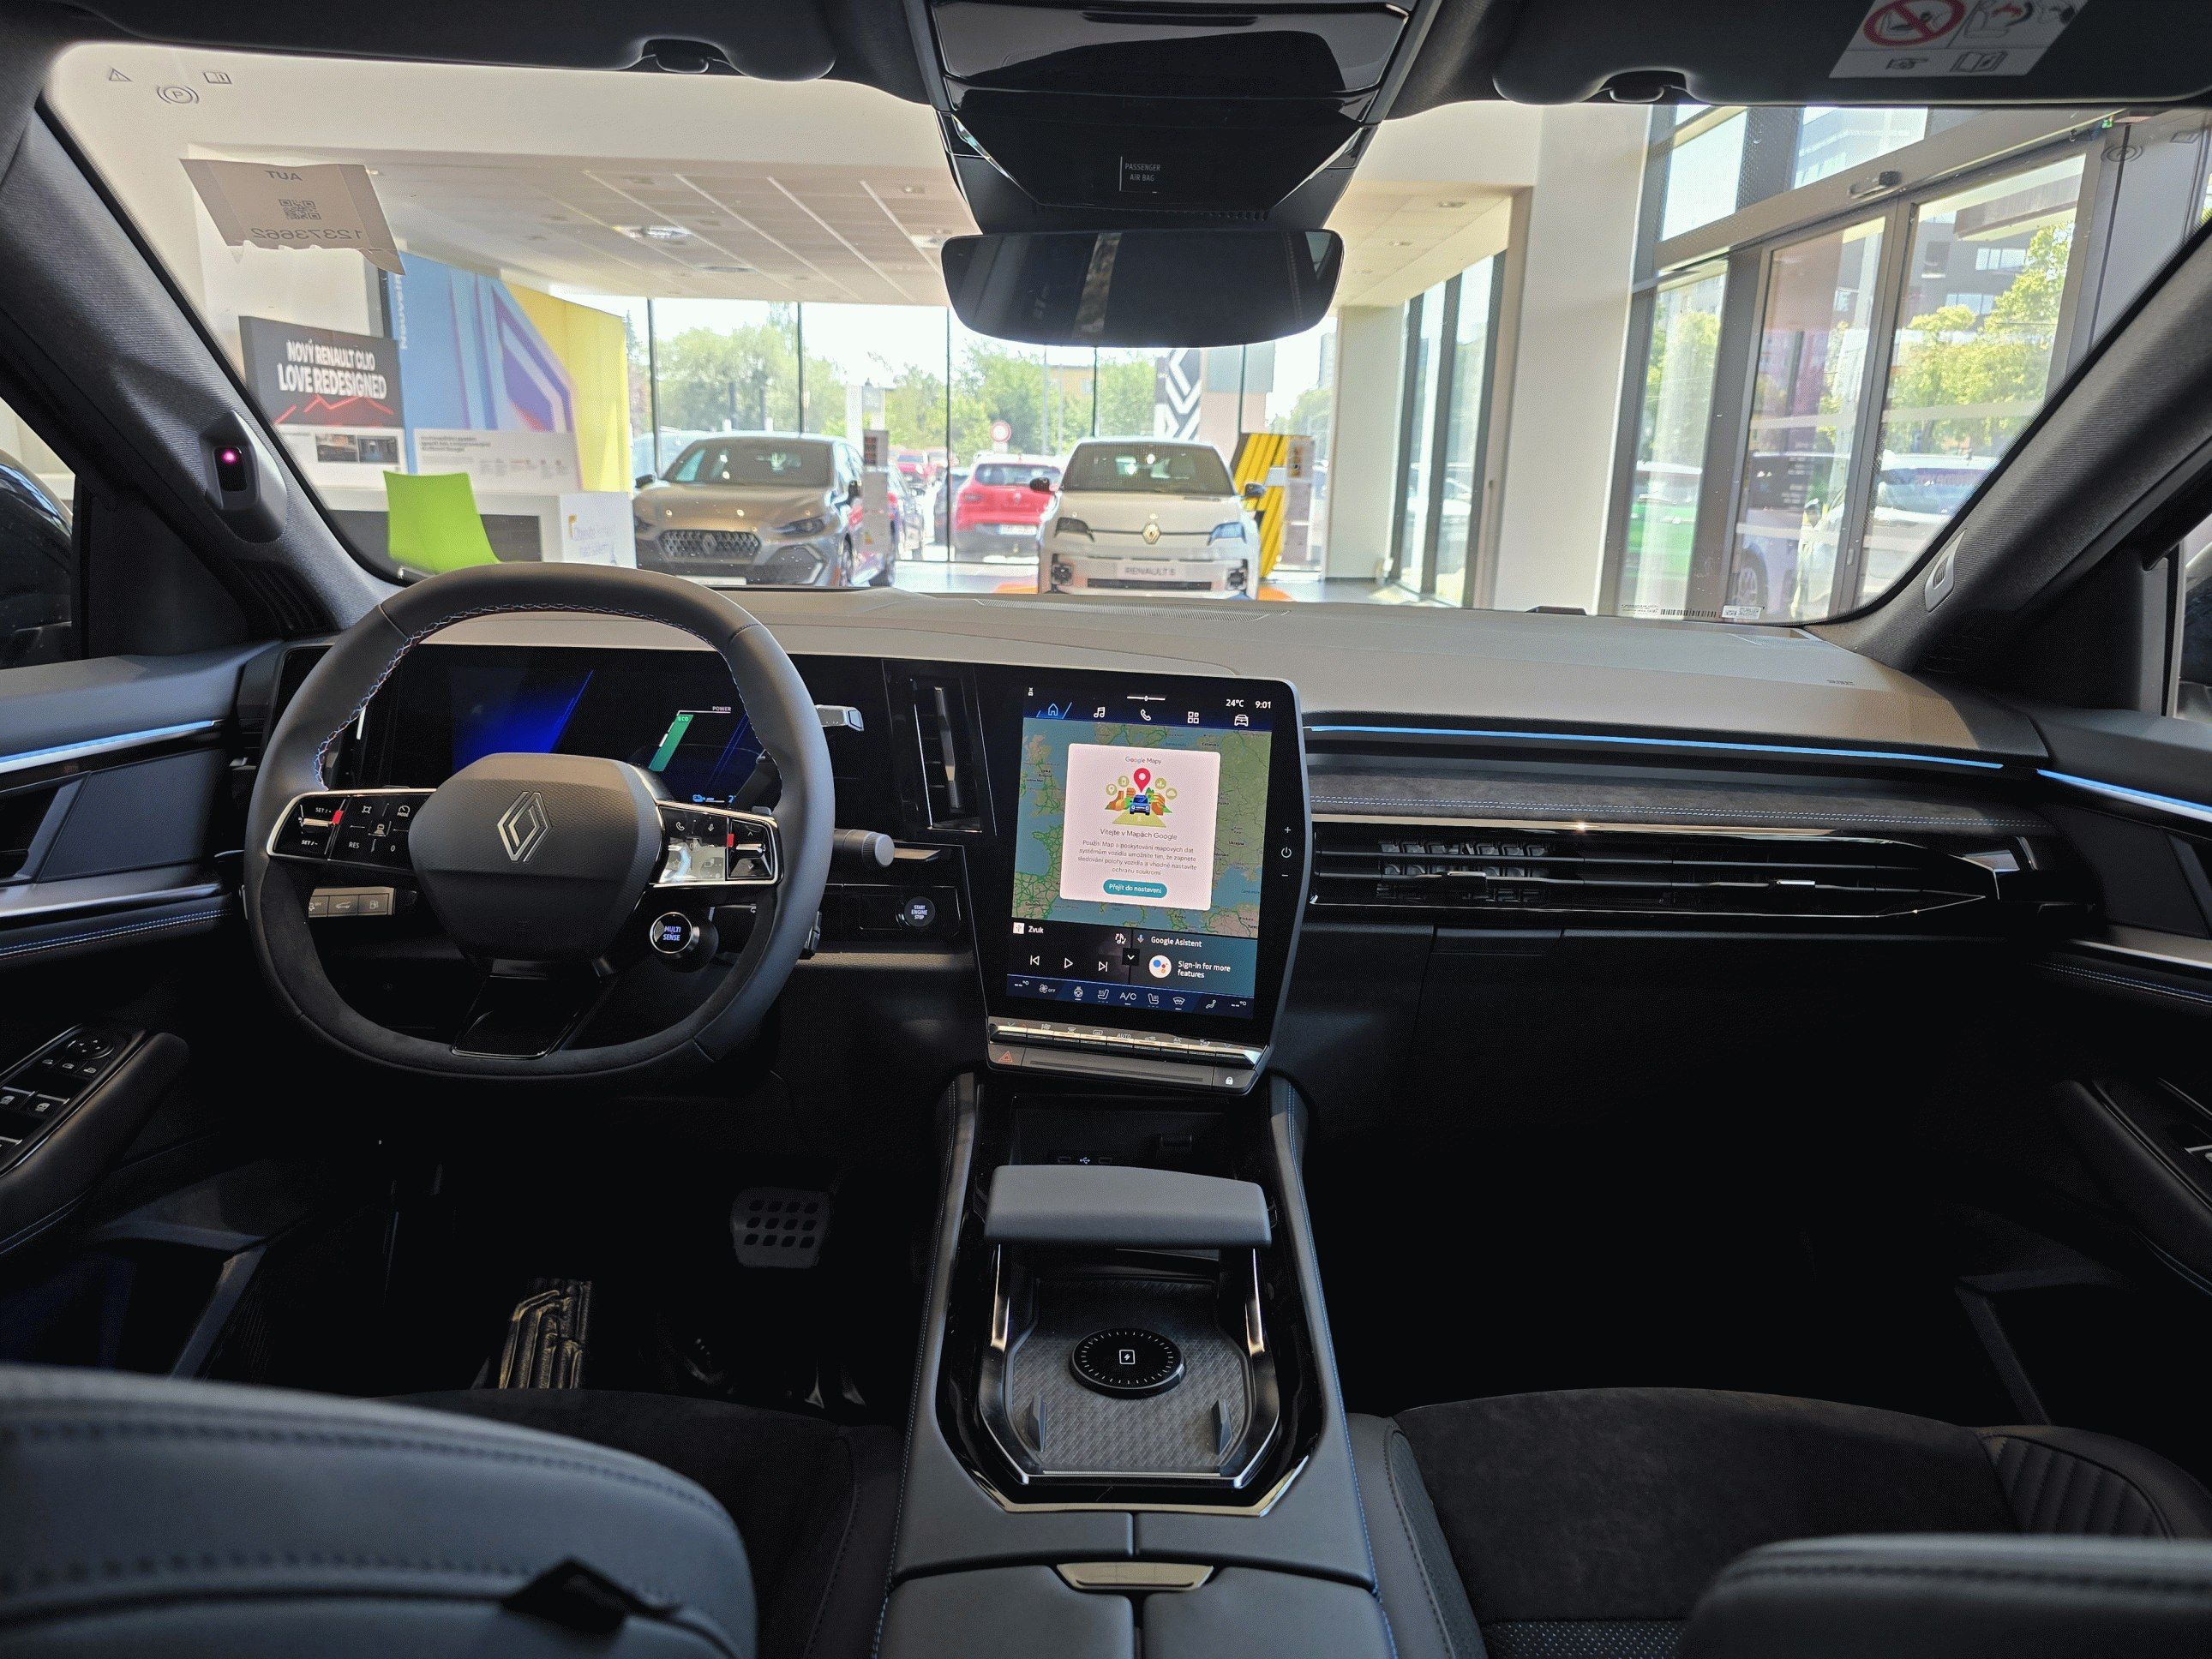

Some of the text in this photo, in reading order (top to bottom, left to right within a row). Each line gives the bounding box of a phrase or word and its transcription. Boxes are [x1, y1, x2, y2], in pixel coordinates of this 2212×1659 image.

[1124, 163, 1161, 171] PASSENGER
[285, 338, 375, 371] NOVÝ RENAULT CLIO
[276, 362, 387, 399] LOVE REDESIGNED
[1226, 698, 1272, 709] 24°C 9:01
[1124, 756, 1146, 764] Google
[1100, 828, 1120, 838] Vítejte
[1127, 830, 1153, 839] Mapách
[1154, 832, 1178, 841] Google
[348, 841, 360, 849] RES
[1108, 883, 1124, 893] Přejít
[1134, 886, 1162, 895] nastavení
[1028, 925, 1044, 934] Zvuk
[1151, 936, 1202, 948] Google Asistent
[1178, 961, 1201, 971] Sign-in
[1202, 961, 1213, 971] for
[1178, 969, 1205, 979] features
[1119, 991, 1137, 1001] A/C
